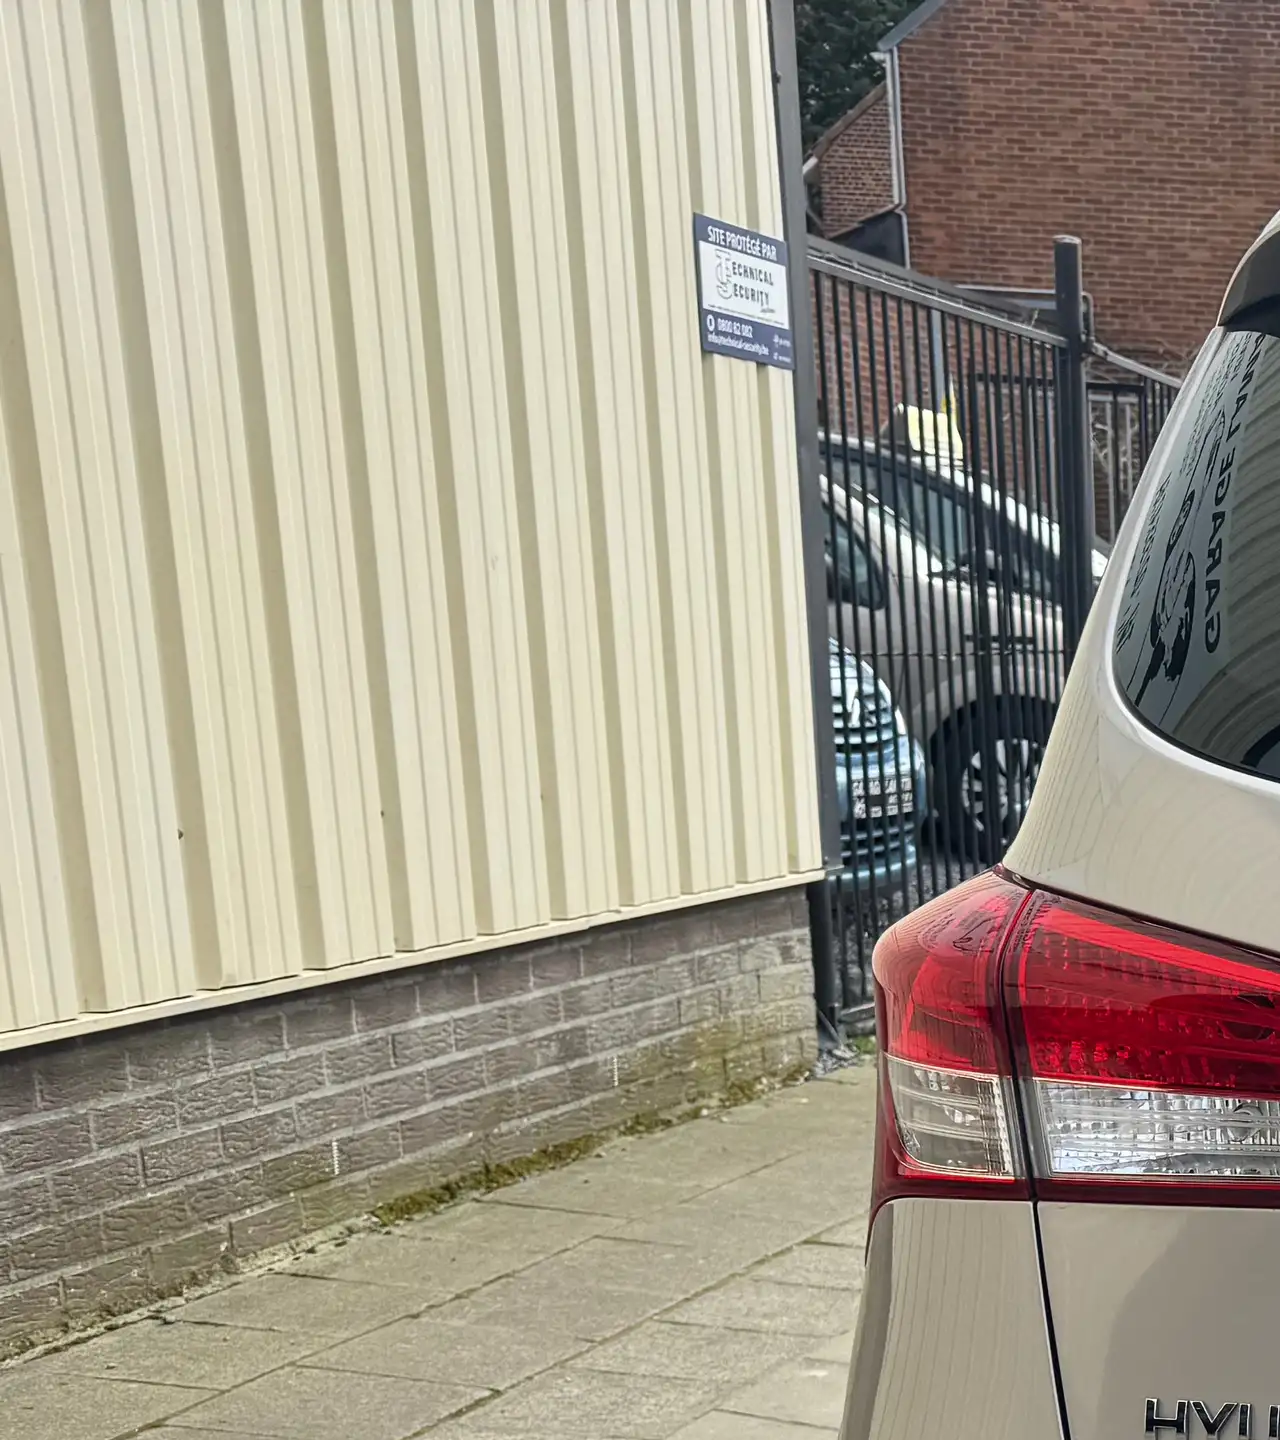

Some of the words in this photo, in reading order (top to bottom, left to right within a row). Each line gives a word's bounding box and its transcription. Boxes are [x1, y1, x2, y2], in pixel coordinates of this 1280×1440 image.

[707, 225, 725, 244] SITE
[726, 230, 761, 256] PROTÉGÉ
[762, 242, 777, 261] PAR
